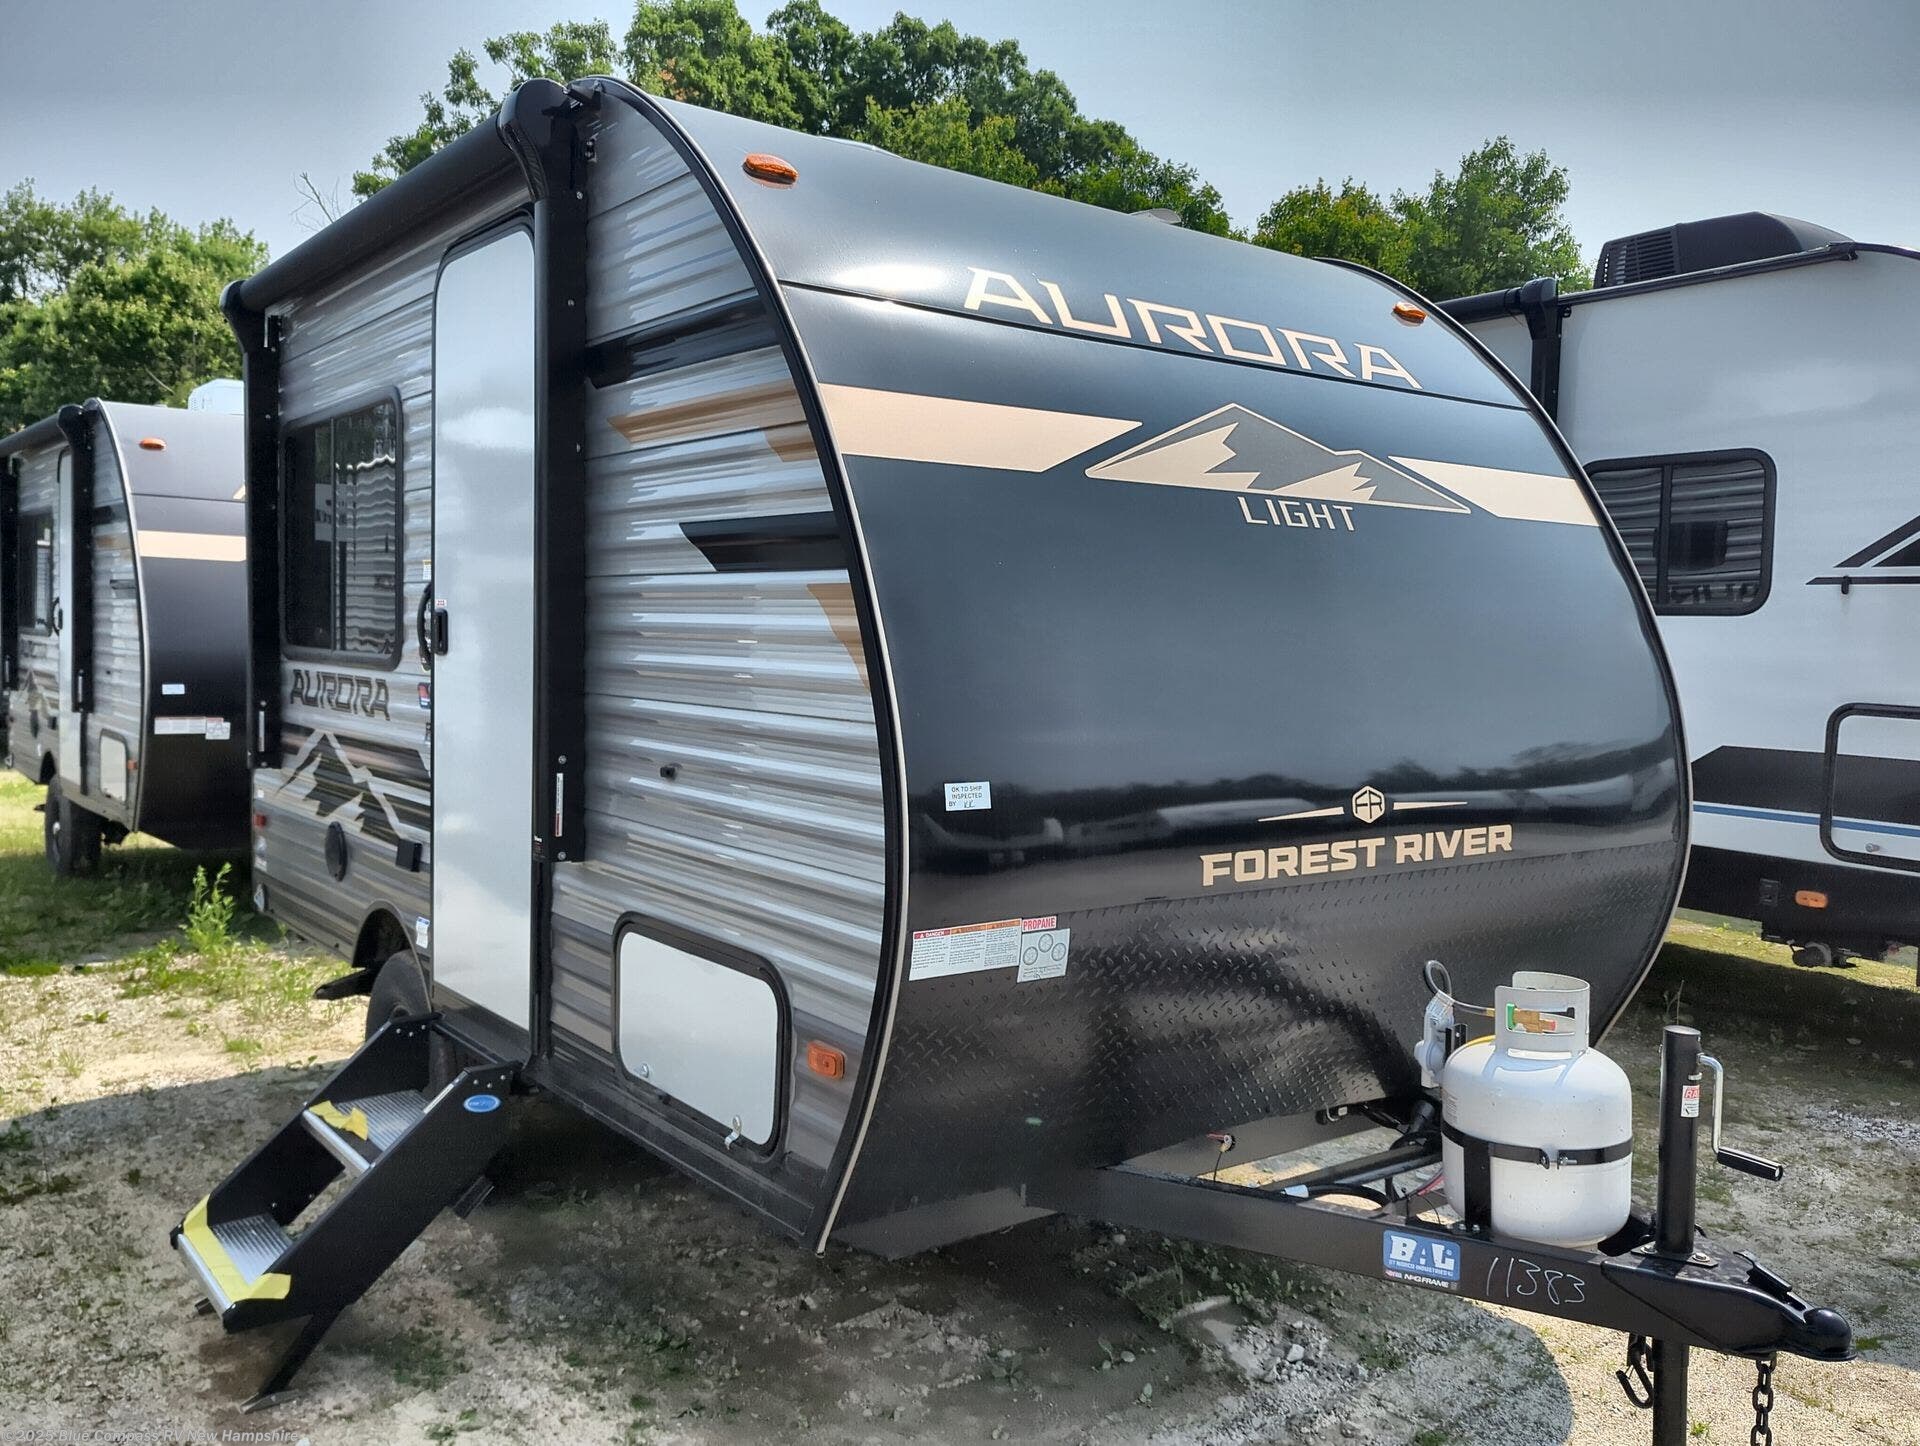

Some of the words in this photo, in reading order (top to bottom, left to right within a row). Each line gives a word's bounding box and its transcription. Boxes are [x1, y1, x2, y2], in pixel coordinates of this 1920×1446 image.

[964, 266, 1423, 389] AURORA
[1237, 496, 1356, 531] LIGHT
[290, 669, 391, 721] AURORA
[951, 792, 983, 800] INSPECTED
[1200, 837, 1385, 886] FOREST
[1394, 824, 1513, 864] RIVER
[1023, 917, 1056, 930] PROPANE
[1486, 1257, 1585, 1305] 11383
